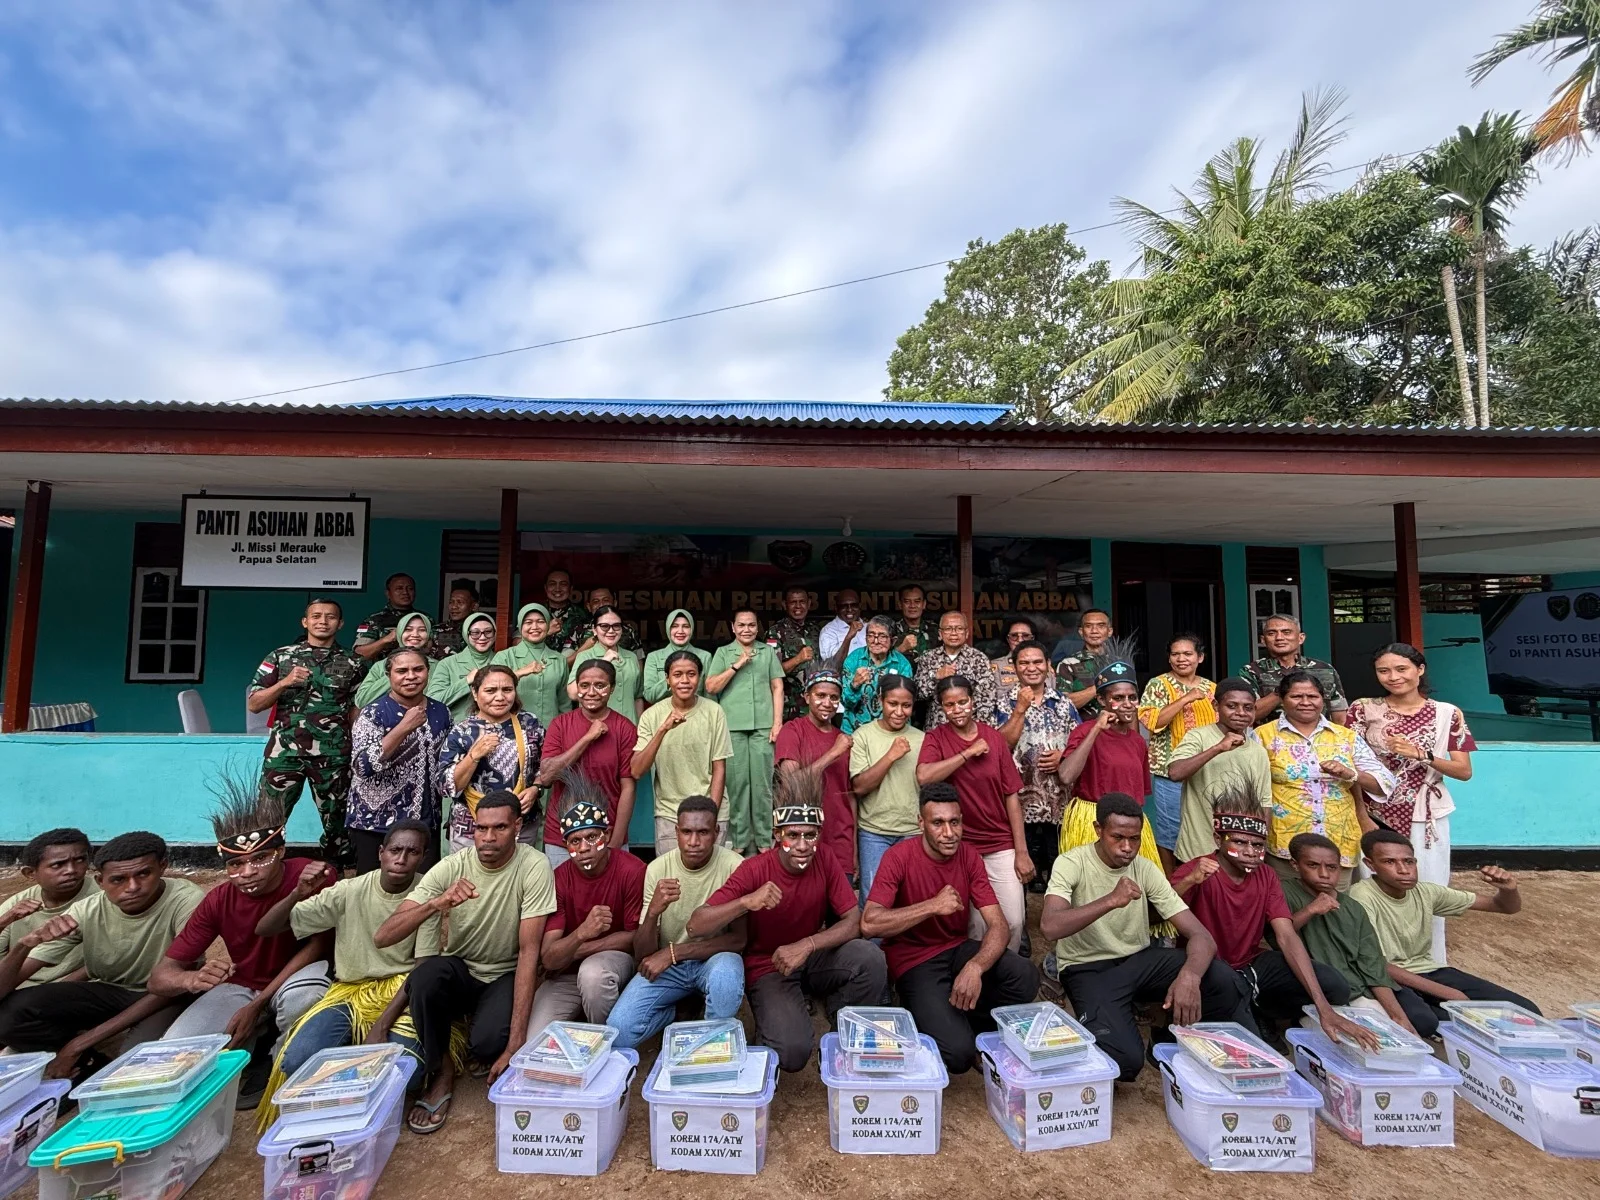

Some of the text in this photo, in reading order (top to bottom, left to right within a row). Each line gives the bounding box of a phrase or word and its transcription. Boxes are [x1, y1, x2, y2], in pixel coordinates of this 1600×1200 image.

[196, 510, 355, 537] PANTI ASUHAN ABBA
[231, 541, 327, 553] Jl. Missi Merauke
[238, 555, 317, 566] Papua Selatan
[1016, 591, 1079, 611] ABBA
[1516, 633, 1600, 644] SESI FOTO BE
[1509, 649, 1521, 658] DI
[1524, 648, 1561, 658] PANTI
[1459, 1068, 1523, 1113] KOREM 174/ATW
[1462, 1081, 1525, 1124] KODAM XXIV/MT
[1036, 1105, 1101, 1123] KOREM 174/ATW
[1373, 1111, 1442, 1121] KOREM 174/ATW
[851, 1117, 923, 1126] KOREM 174/ATW
[1038, 1118, 1100, 1136] KODAM XXIV/MT
[852, 1129, 922, 1139] KODAM XXIV/MT
[1375, 1124, 1442, 1133] KODAM XXIV/MT
[512, 1133, 586, 1145] KOREM 174/ATW
[670, 1134, 744, 1145] KOREM 174/ATW
[1221, 1135, 1297, 1145] KOREM 174/ATW
[512, 1147, 584, 1158] KODAM XXIV/MT
[671, 1147, 743, 1158] KODAM XXIV/MT
[1223, 1148, 1297, 1159] KODAM XXIV/MT
